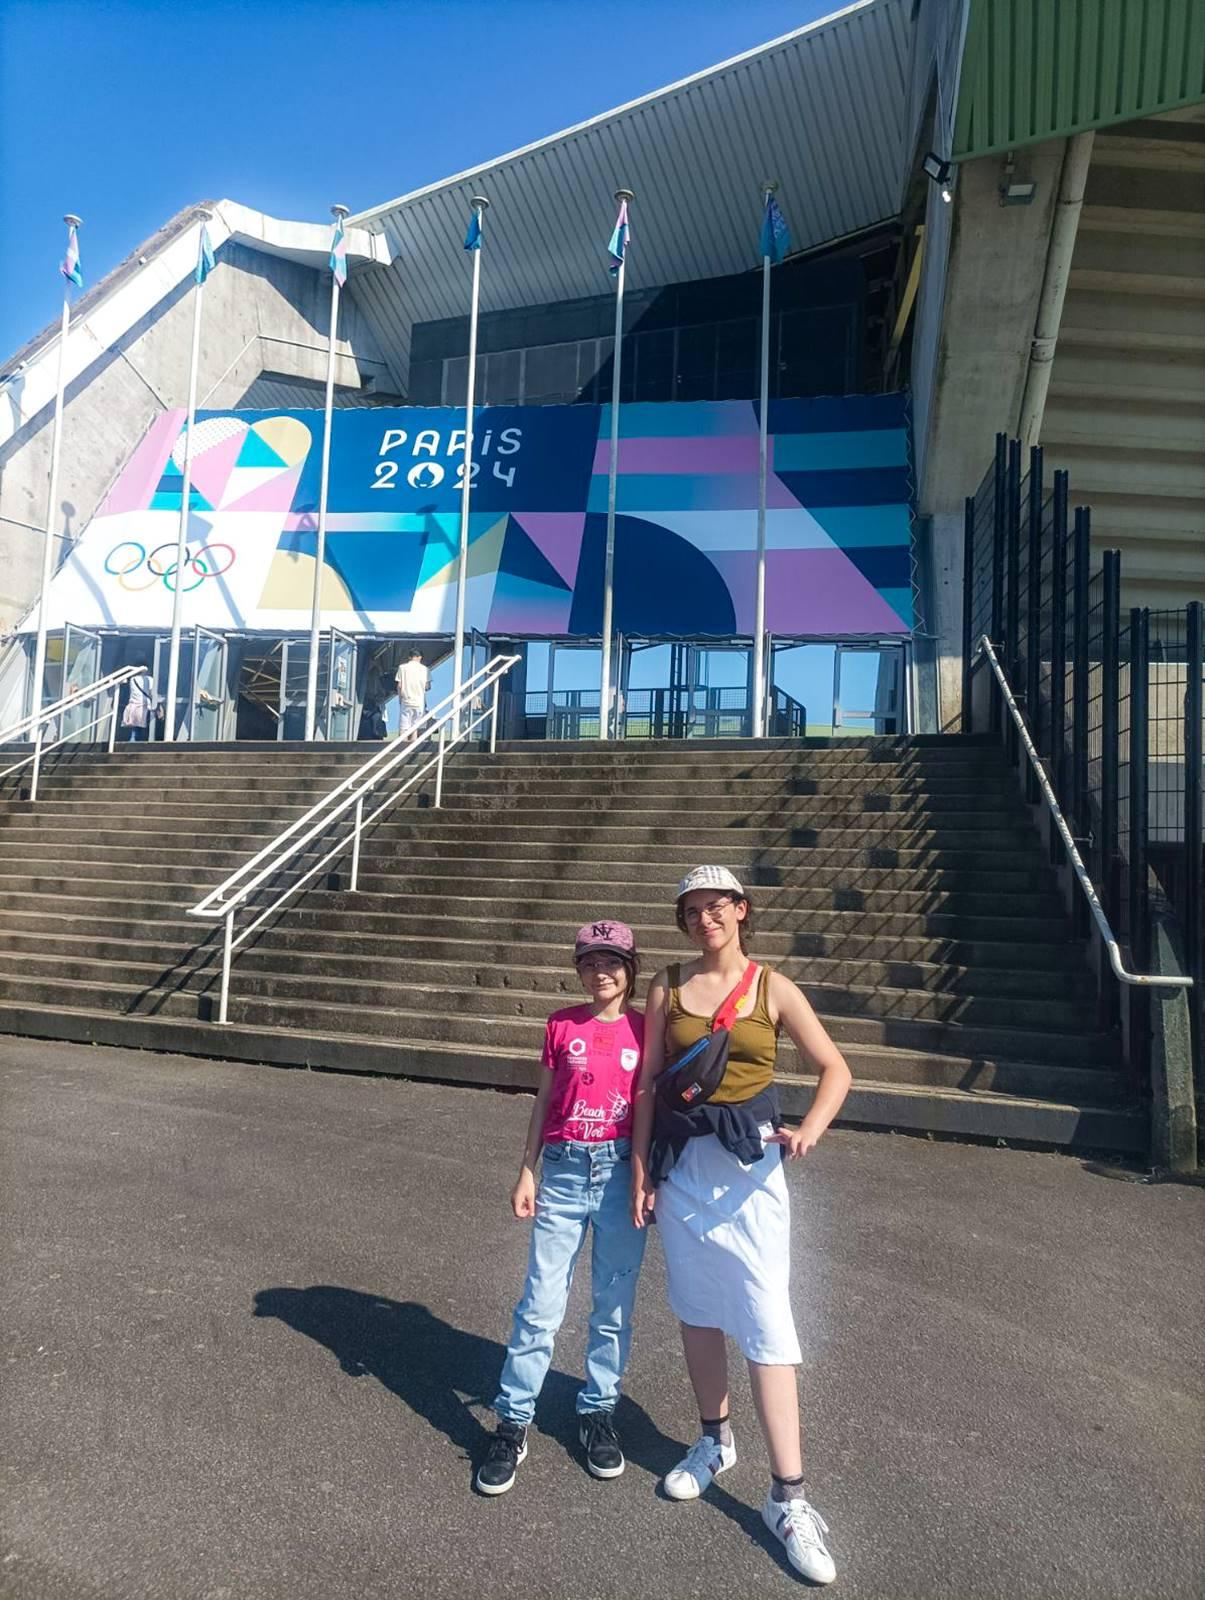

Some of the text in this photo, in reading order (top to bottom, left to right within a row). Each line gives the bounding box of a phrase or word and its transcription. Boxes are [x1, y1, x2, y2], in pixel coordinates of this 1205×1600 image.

[370, 461, 516, 489] 2024
[591, 923, 614, 940] NY
[573, 1099, 606, 1118] Beach
